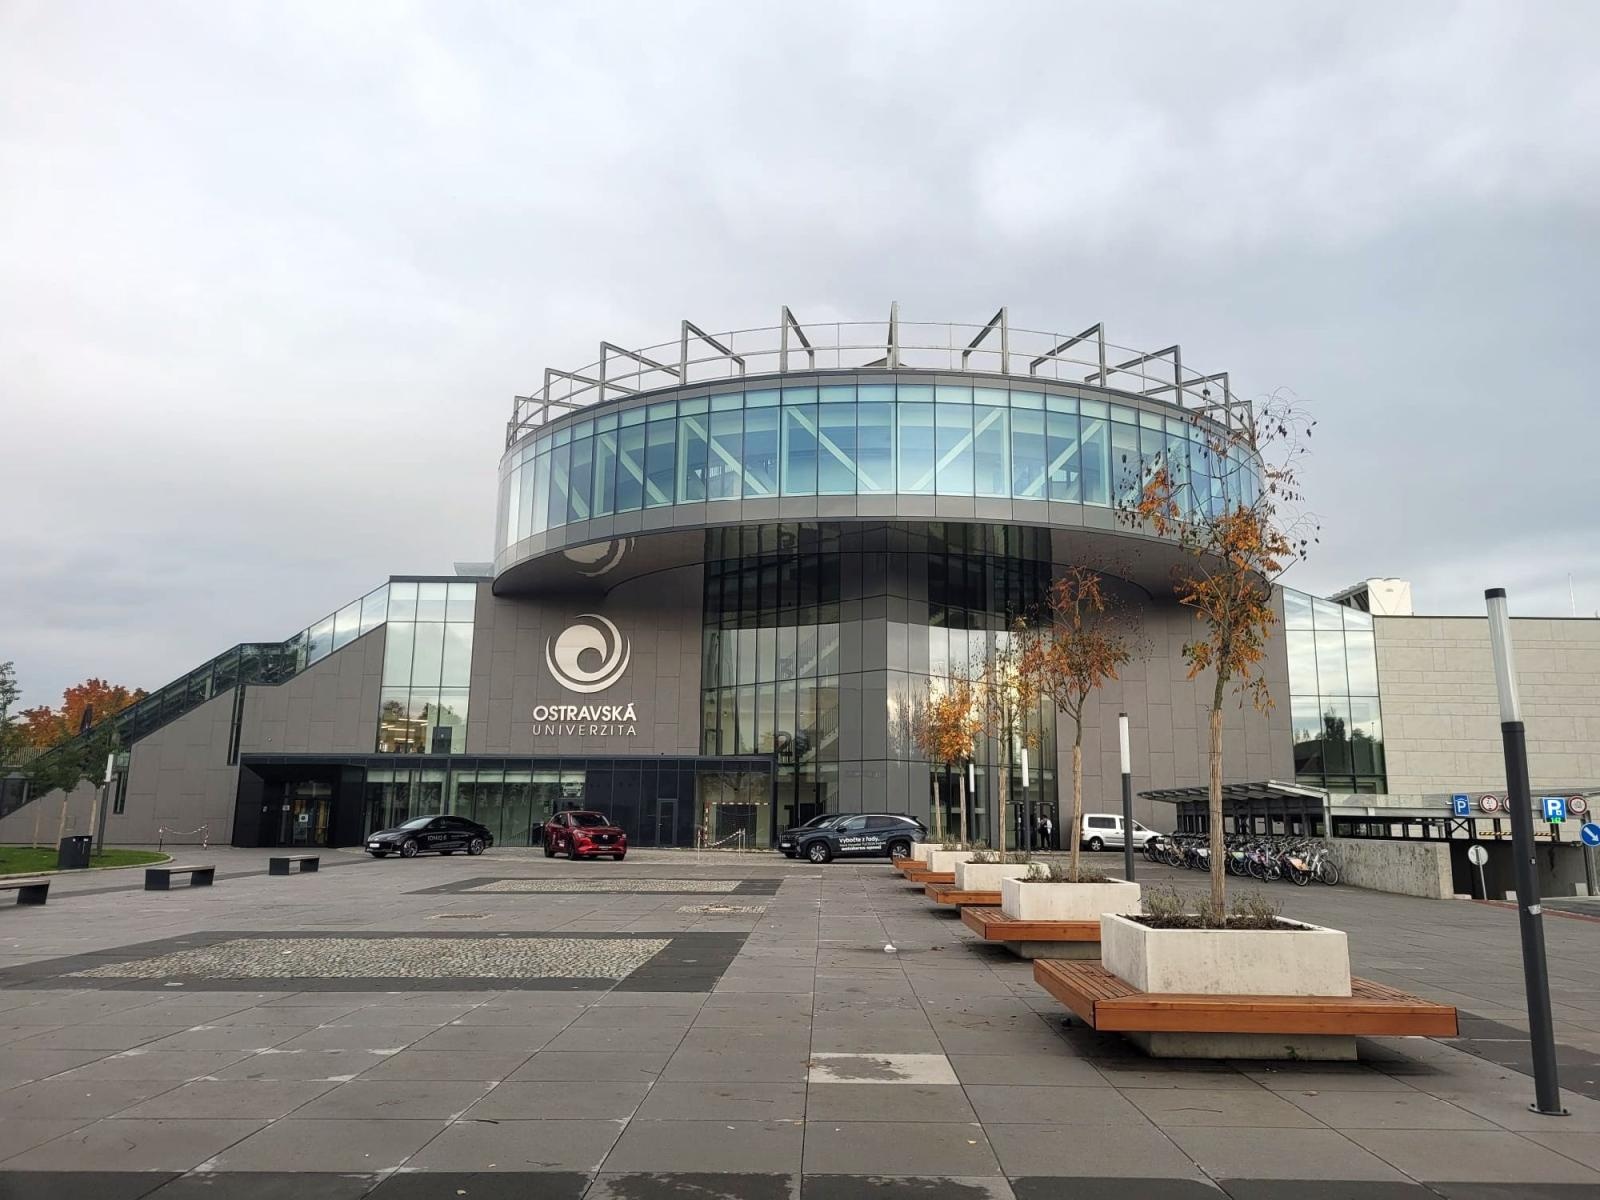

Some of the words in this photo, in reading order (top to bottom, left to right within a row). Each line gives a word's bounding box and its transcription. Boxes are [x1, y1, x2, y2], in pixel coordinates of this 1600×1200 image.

[533, 703, 637, 721] OSTRAVSKÁ
[532, 724, 637, 736] UNIVERZITA
[1457, 801, 1467, 812] P
[1547, 800, 1561, 815] P
